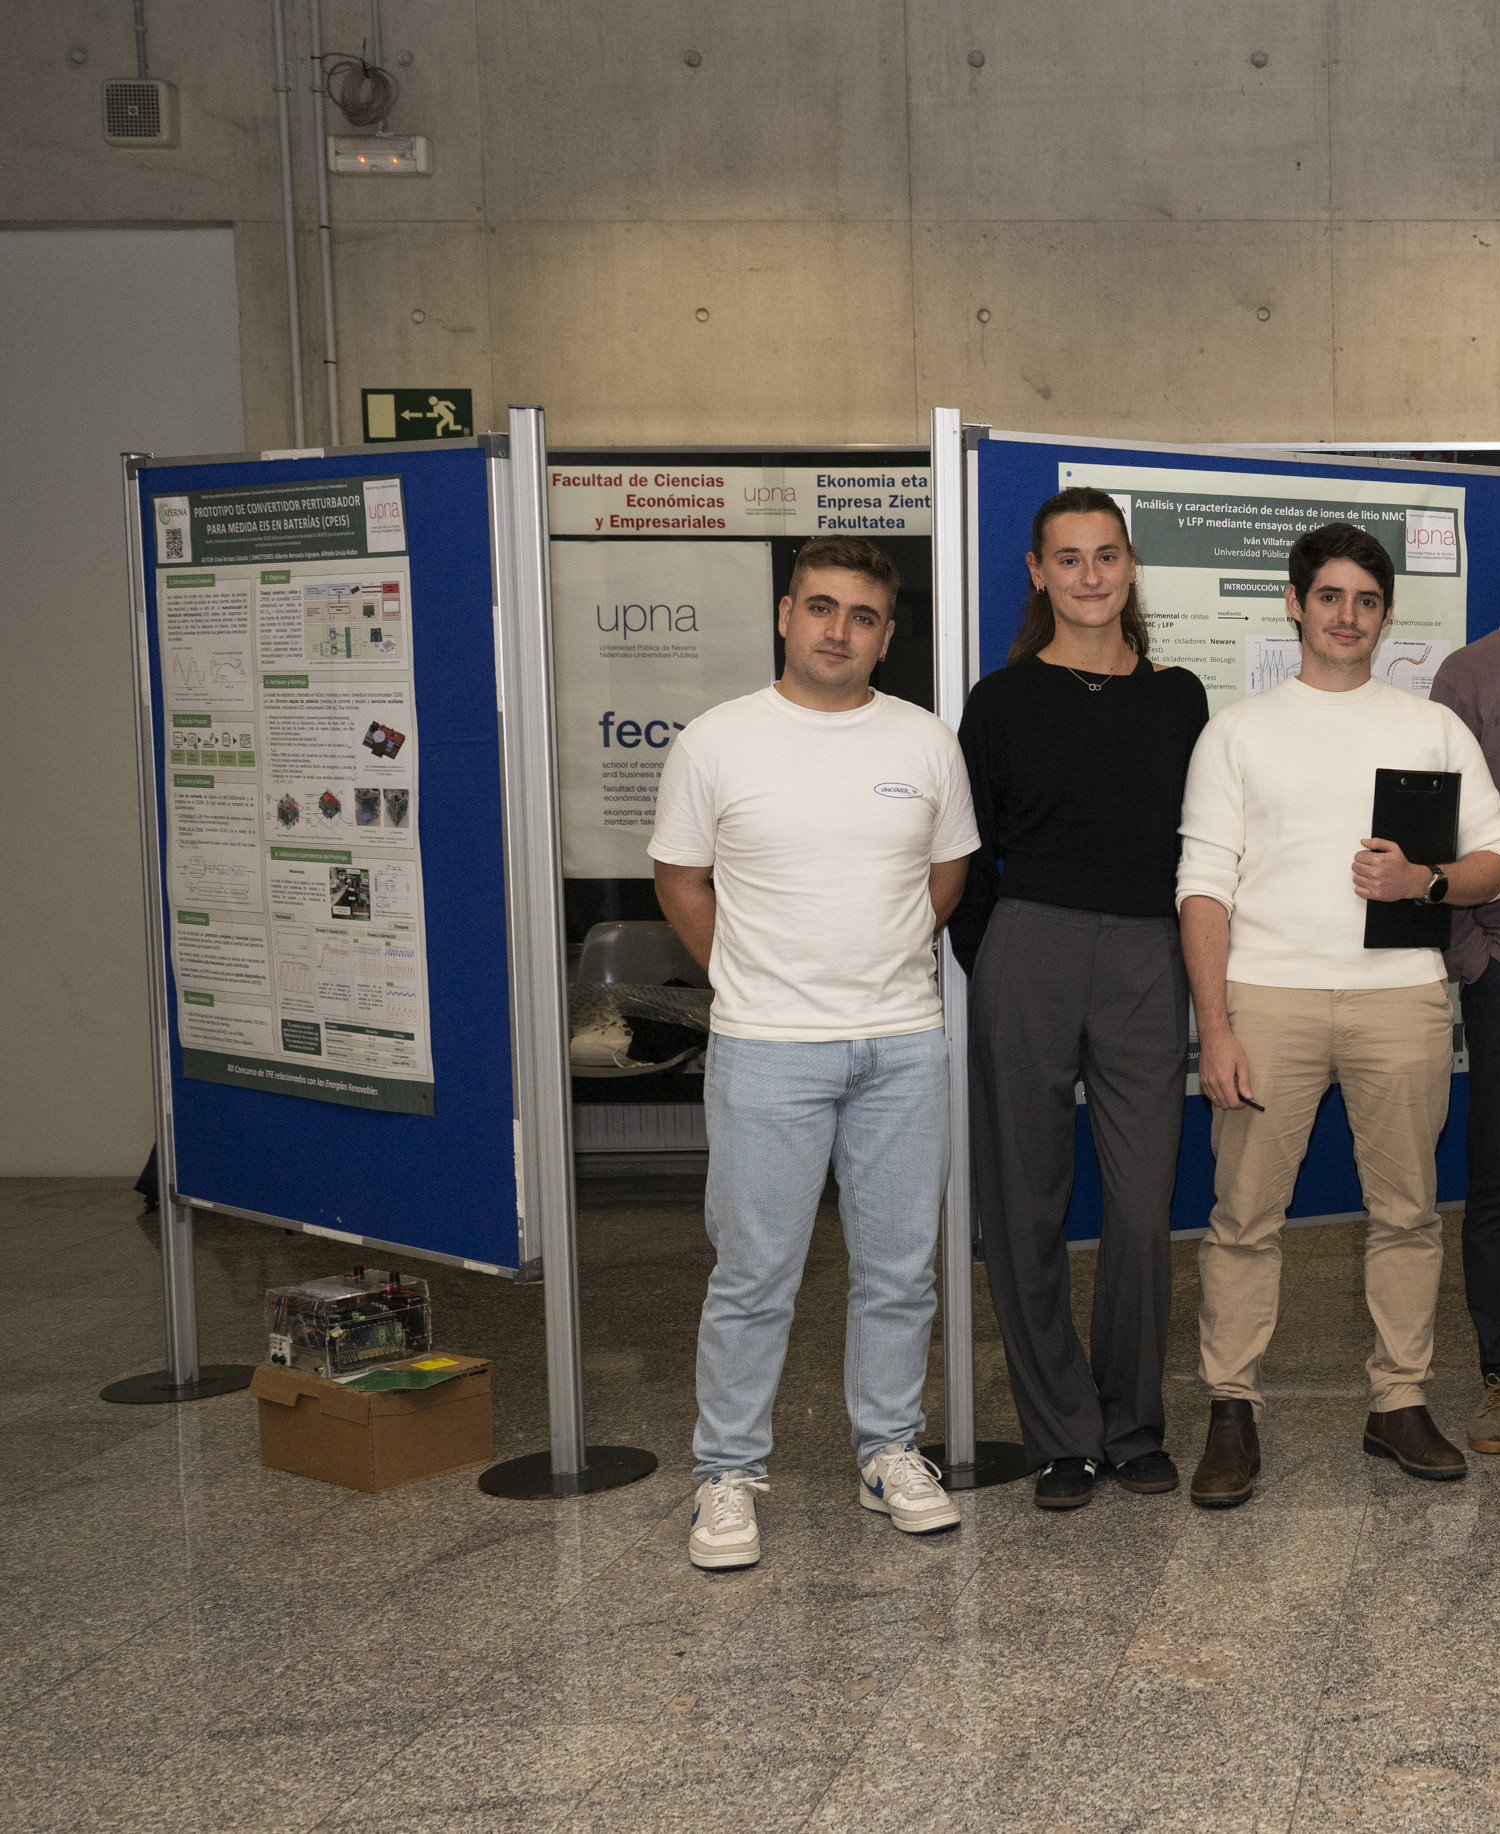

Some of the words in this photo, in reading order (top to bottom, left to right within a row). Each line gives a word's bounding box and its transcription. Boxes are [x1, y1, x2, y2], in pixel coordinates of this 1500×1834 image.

[552, 473, 623, 487] Facultad
[628, 474, 648, 487] de
[654, 474, 725, 487] Ciencias
[817, 474, 895, 488] Ekonomia
[902, 474, 928, 488] eta
[626, 494, 725, 508] Económicas
[744, 487, 797, 506] upna
[817, 495, 882, 511] Enpresa
[888, 495, 931, 508] Zient
[194, 504, 234, 518] PROTOTIPO
[236, 502, 246, 516] DE
[247, 498, 300, 515] CONVERTIDOR
[302, 494, 361, 511] PERTURBADOR
[369, 500, 400, 522] upna
[1135, 499, 1174, 511] Análisis
[1176, 502, 1183, 513] y
[1185, 500, 1258, 515] caracterización
[1260, 506, 1273, 516] de
[1275, 507, 1304, 517] celdas
[1307, 508, 1319, 518] de
[1320, 508, 1345, 519] iones
[1347, 510, 1359, 520] de
[1361, 510, 1379, 521] litio
[1382, 511, 1405, 522] NMC
[207, 522, 226, 535] PARA
[228, 520, 258, 534] MEDIDA
[260, 520, 271, 532] EIS
[272, 518, 282, 531] EN
[284, 514, 321, 530] BATERÍAS
[322, 514, 351, 530] (CPEIS)
[595, 518, 603, 531] y
[610, 514, 726, 531] Empresariales
[818, 516, 906, 529] Fakultatea
[1178, 519, 1185, 528] y
[1187, 517, 1204, 527] LFP
[1206, 518, 1253, 530] mediante
[1255, 522, 1293, 532] ensayos
[1295, 522, 1307, 532] de
[1243, 536, 1261, 546] Iván
[1406, 528, 1456, 549] upna
[1214, 547, 1261, 558] Universidad
[1262, 549, 1290, 559] Pública
[1224, 582, 1279, 592] INTRODUCCIÓN
[597, 603, 699, 640] upna
[1210, 657, 1237, 665] BioLogic
[602, 761, 628, 769] school
[630, 761, 638, 769] of
[603, 785, 635, 793] facultad
[636, 785, 647, 793] de
[603, 794, 651, 802] económicas
[235, 1065, 257, 1076] Concurso
[258, 1068, 265, 1077] de
[266, 1070, 275, 1079] TFE
[275, 1071, 307, 1085] relacionados
[307, 1077, 316, 1085] con
[317, 1077, 325, 1086] las
[326, 1079, 348, 1092] Energías
[348, 1083, 378, 1096] Renovables
